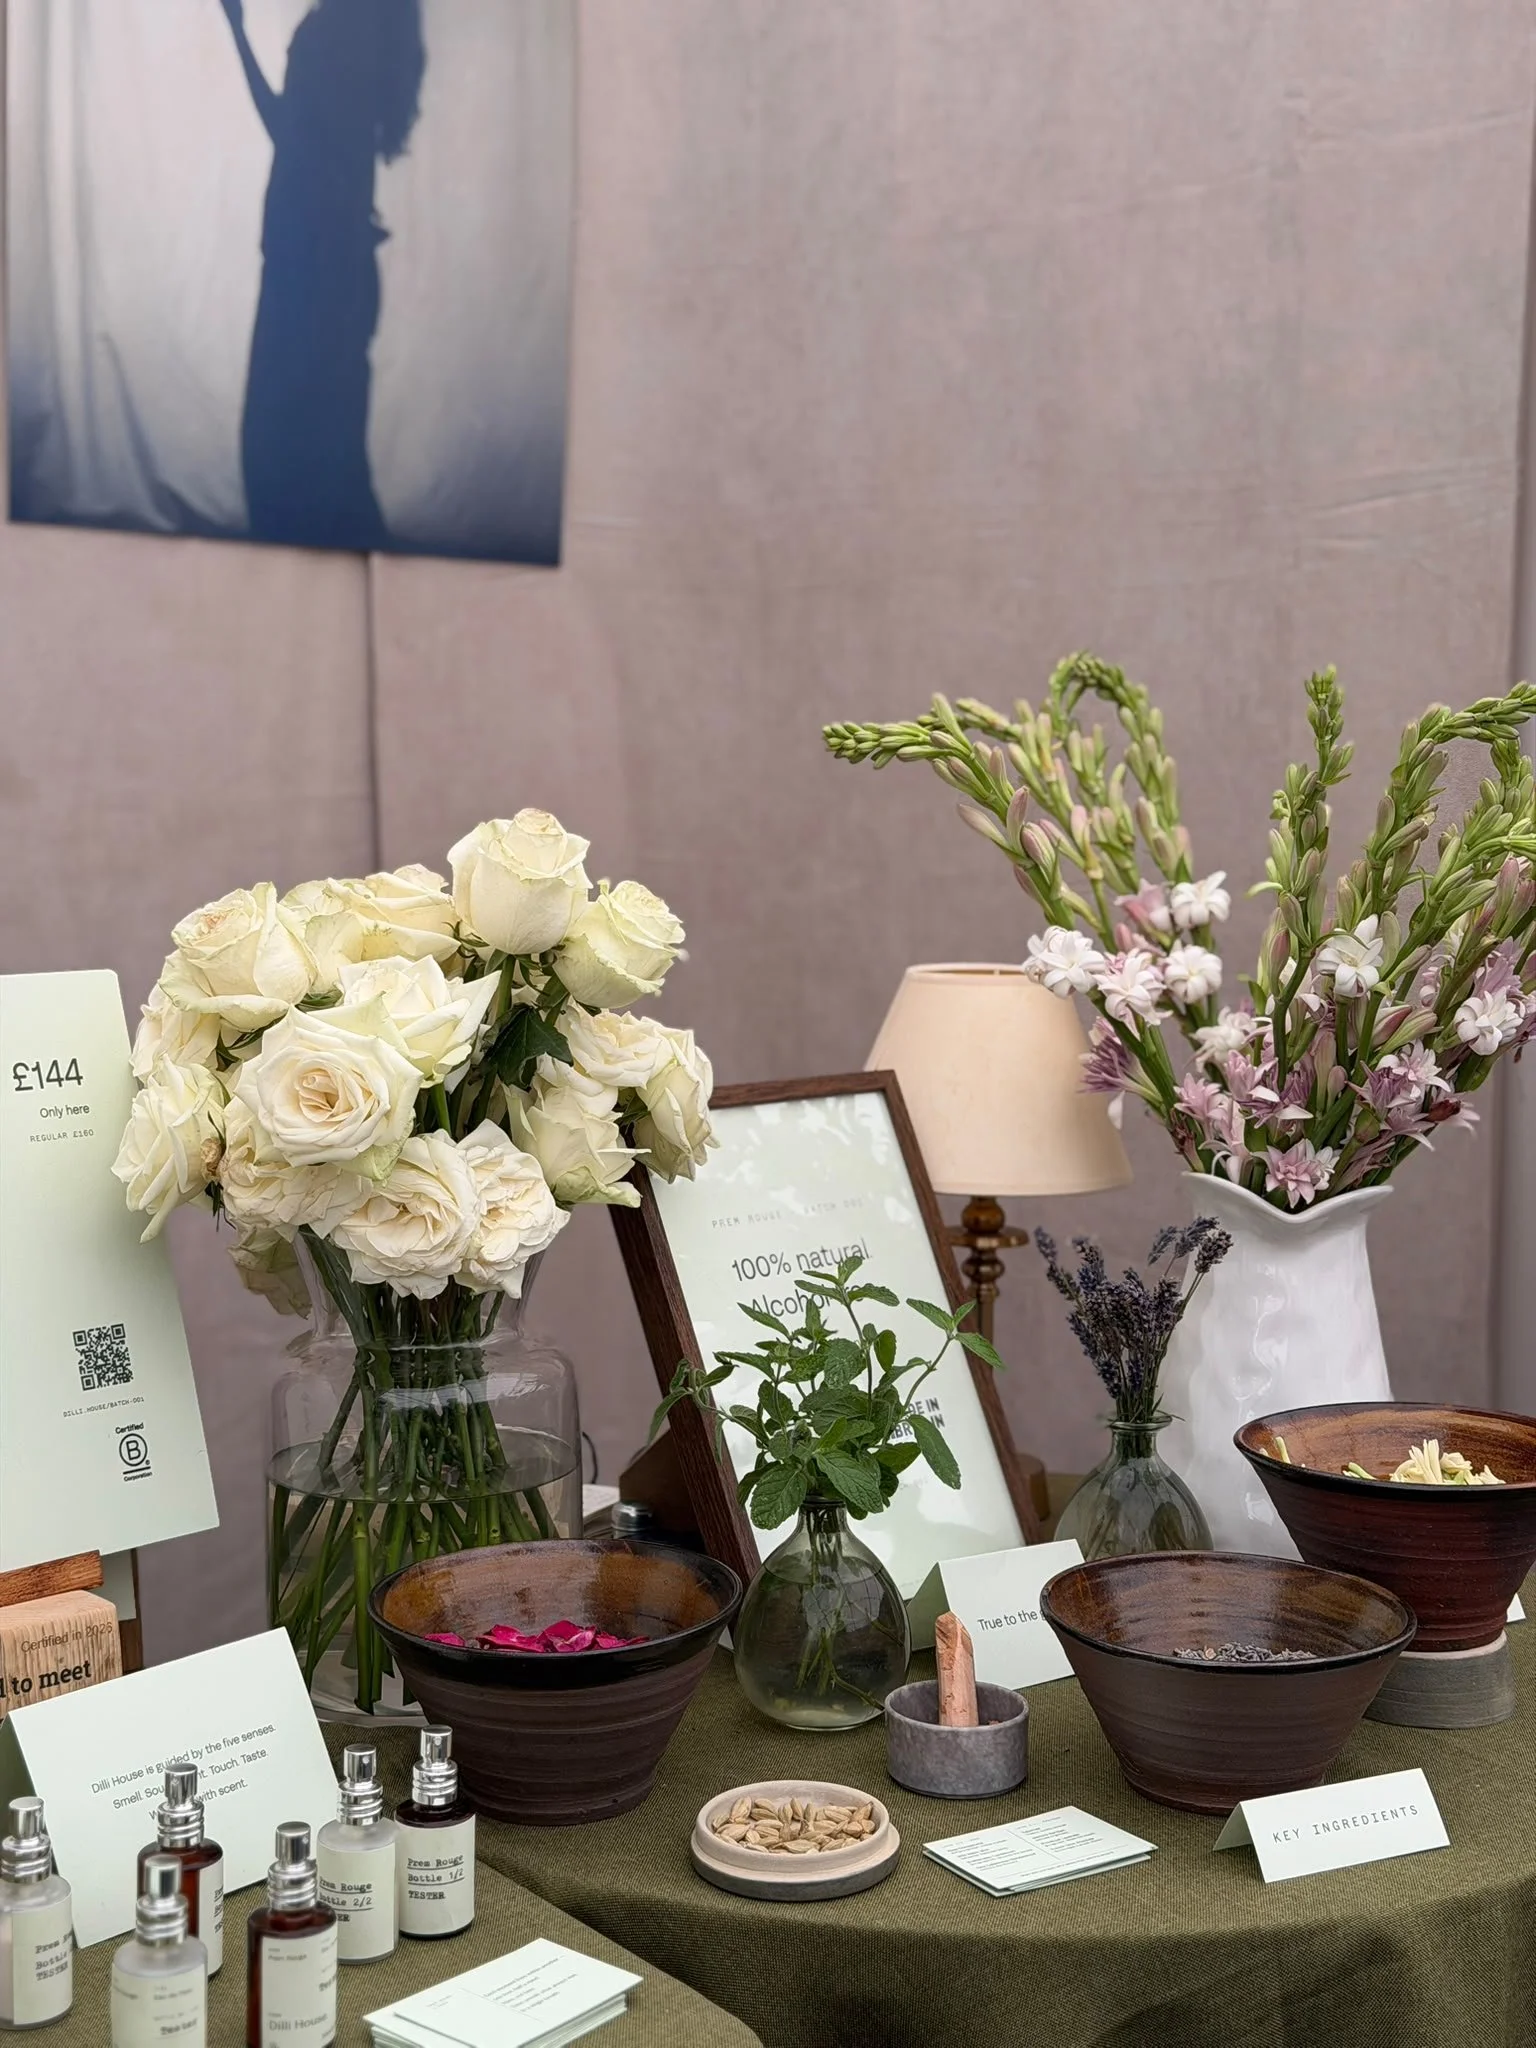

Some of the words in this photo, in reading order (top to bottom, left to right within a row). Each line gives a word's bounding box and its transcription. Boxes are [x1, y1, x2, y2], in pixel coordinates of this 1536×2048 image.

[12, 1058, 83, 1092] £144
[40, 1105, 63, 1119] Only
[65, 1104, 90, 1116] here
[30, 1132, 68, 1142] REGULAR
[73, 1129, 94, 1139] £160
[731, 1251, 792, 1281] 100%
[925, 1397, 940, 1412] IN
[115, 1422, 144, 1434] Certified
[126, 1440, 141, 1461] B
[124, 1471, 152, 1482] Corporation
[977, 1617, 1003, 1630] True
[1004, 1614, 1017, 1626] to
[1018, 1610, 1038, 1622] the
[21, 1632, 68, 1652] Certified
[72, 1630, 82, 1640] in
[11, 1676, 33, 1695] to
[38, 1660, 92, 1689] meet
[91, 1780, 111, 1794] Dilli
[111, 1769, 144, 1787] House
[145, 1765, 154, 1775] is
[190, 1748, 203, 1760] by
[205, 1741, 222, 1754] the
[222, 1735, 241, 1748] five
[1272, 1828, 1300, 1843] KEY
[1312, 1804, 1418, 1835] INGREDIENTS
[407, 1858, 431, 1867] Prem
[435, 1854, 464, 1867] Rouge
[407, 1872, 442, 1882] Bottle
[449, 1867, 464, 1880] 1/2
[340, 1882, 372, 1893] Rouge
[408, 1889, 445, 1900] TESTER
[353, 1896, 372, 1908] 2/2
